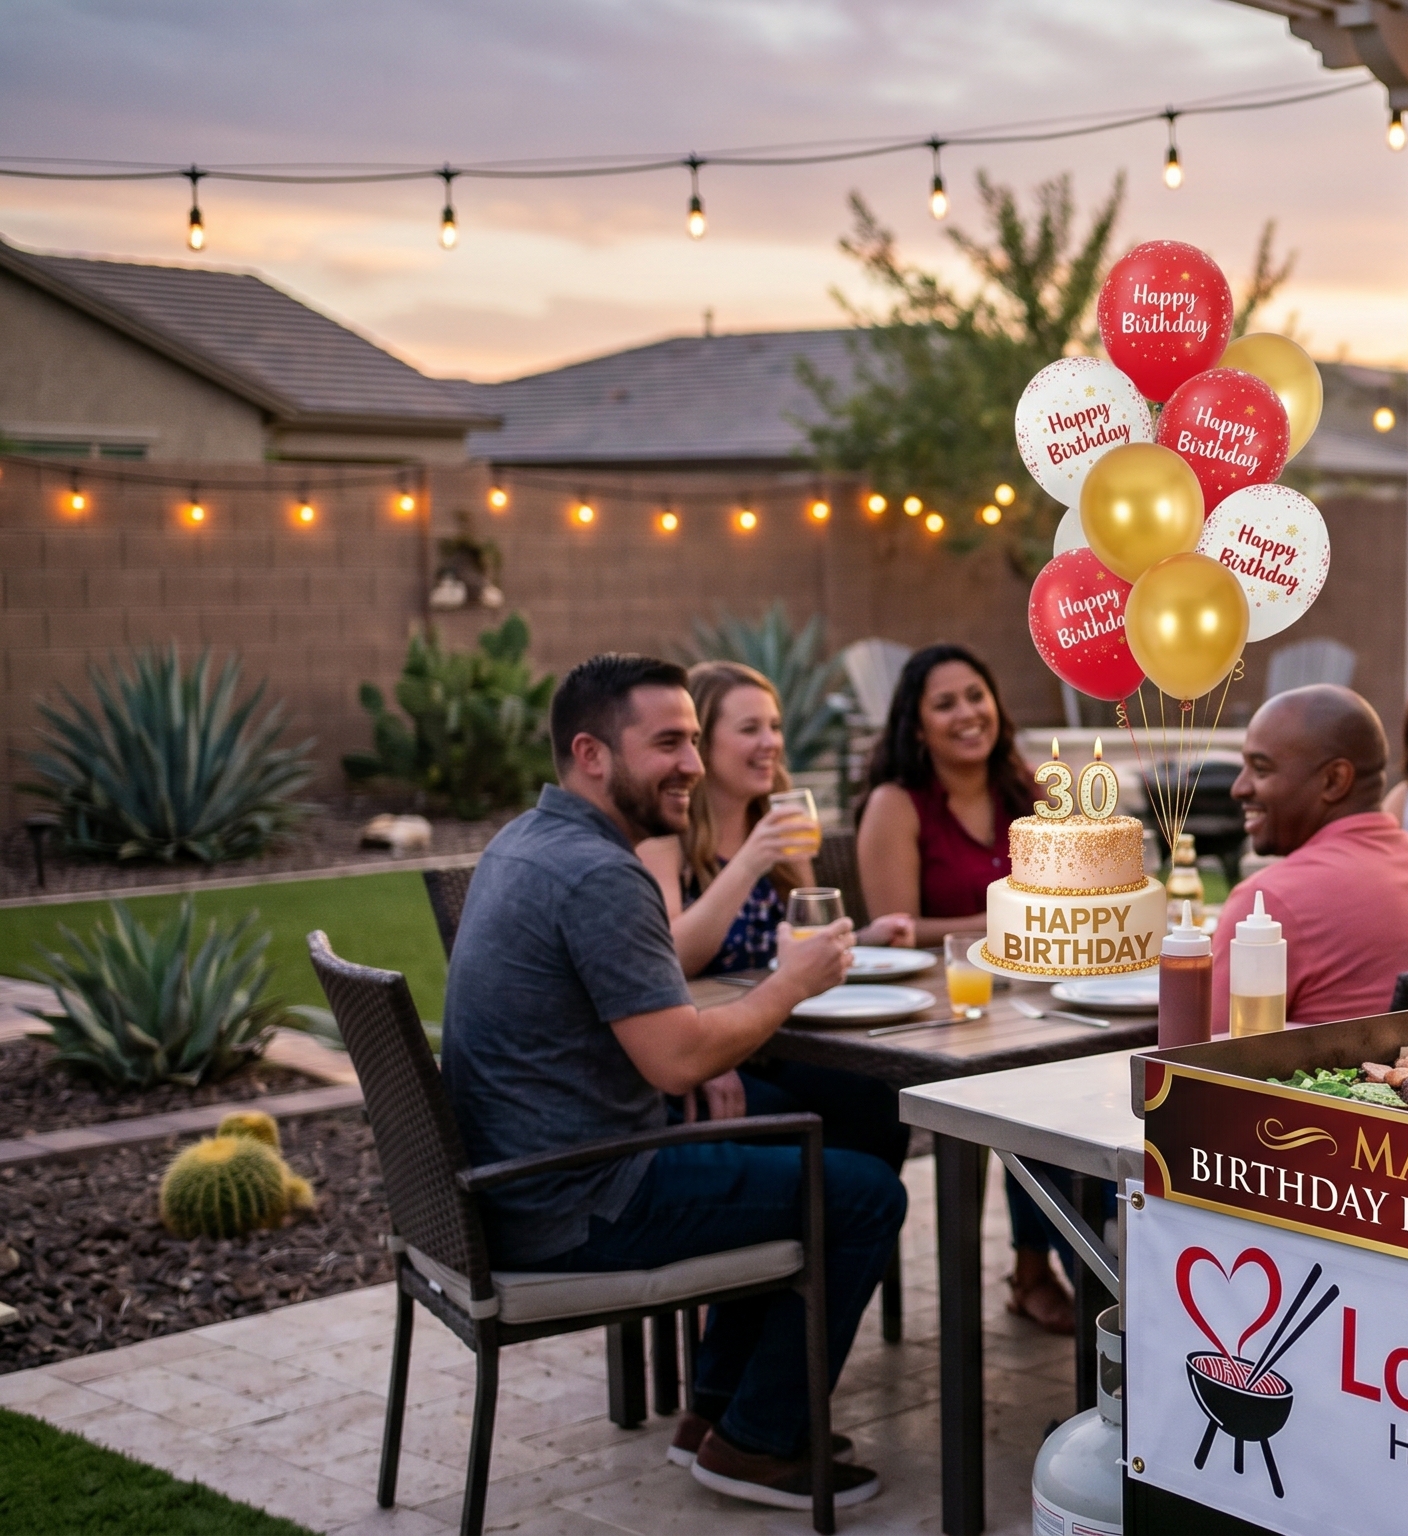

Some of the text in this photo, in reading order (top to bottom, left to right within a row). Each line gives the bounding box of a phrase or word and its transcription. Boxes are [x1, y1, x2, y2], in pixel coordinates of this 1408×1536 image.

[1133, 283, 1199, 314] Happy
[1122, 311, 1212, 343] Birthday
[1047, 403, 1111, 434] Happy
[1195, 406, 1258, 446] Happy
[1046, 424, 1131, 465] Birthday
[1177, 430, 1261, 476] Birthday
[1238, 524, 1299, 566] Happy
[1219, 547, 1299, 596] Birthday
[1058, 589, 1119, 619] Happy
[1056, 610, 1126, 649] Birthda
[1033, 760, 1120, 821] 30
[1025, 905, 1132, 934] HAPPY
[1004, 932, 1153, 965] BIRTHDAY
[1190, 1147, 1390, 1225] BIRTHDAY
